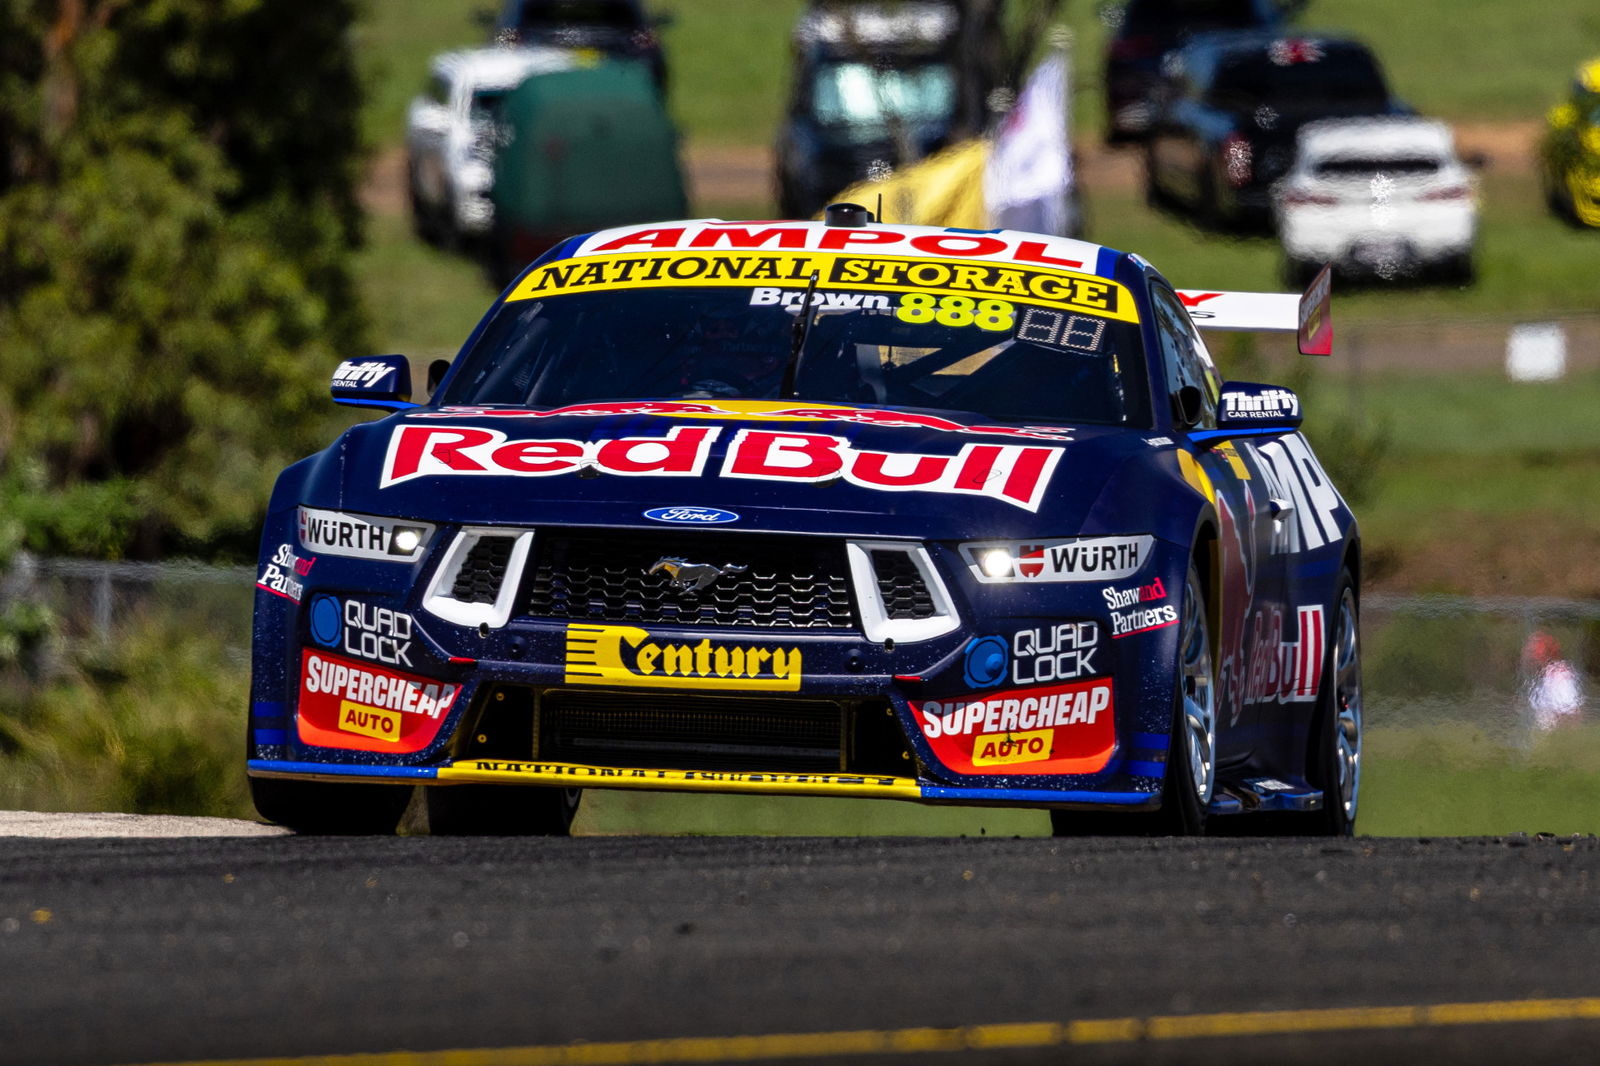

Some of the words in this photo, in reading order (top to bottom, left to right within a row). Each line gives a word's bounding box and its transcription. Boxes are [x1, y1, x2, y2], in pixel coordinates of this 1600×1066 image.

[590, 227, 1084, 269] AMPOL
[531, 256, 819, 292] NATIONAL
[840, 259, 1108, 309] STORAGE
[750, 287, 892, 310] Brown
[896, 292, 1014, 331] 888
[1222, 389, 1298, 417] Thrifty
[1228, 410, 1248, 418] CAR
[1250, 410, 1285, 418] RENTAL
[380, 424, 723, 489] Red
[719, 428, 1065, 513] Bull
[661, 508, 721, 522] Ford
[308, 517, 384, 551] WÜRTH
[1051, 542, 1138, 573] WÜRTH
[1102, 586, 1142, 610] Shaw
[345, 600, 412, 639] QUAD
[1110, 604, 1178, 635] Partners
[345, 627, 414, 667] LOCK
[1013, 621, 1098, 656] QUAD
[565, 623, 801, 691] Century
[1013, 647, 1097, 684] LOCK
[306, 656, 455, 719] SUPERCHEAP
[345, 709, 394, 734] AUTO
[922, 686, 1110, 738] SUPERCHEAP
[981, 737, 1045, 759] AUTO
